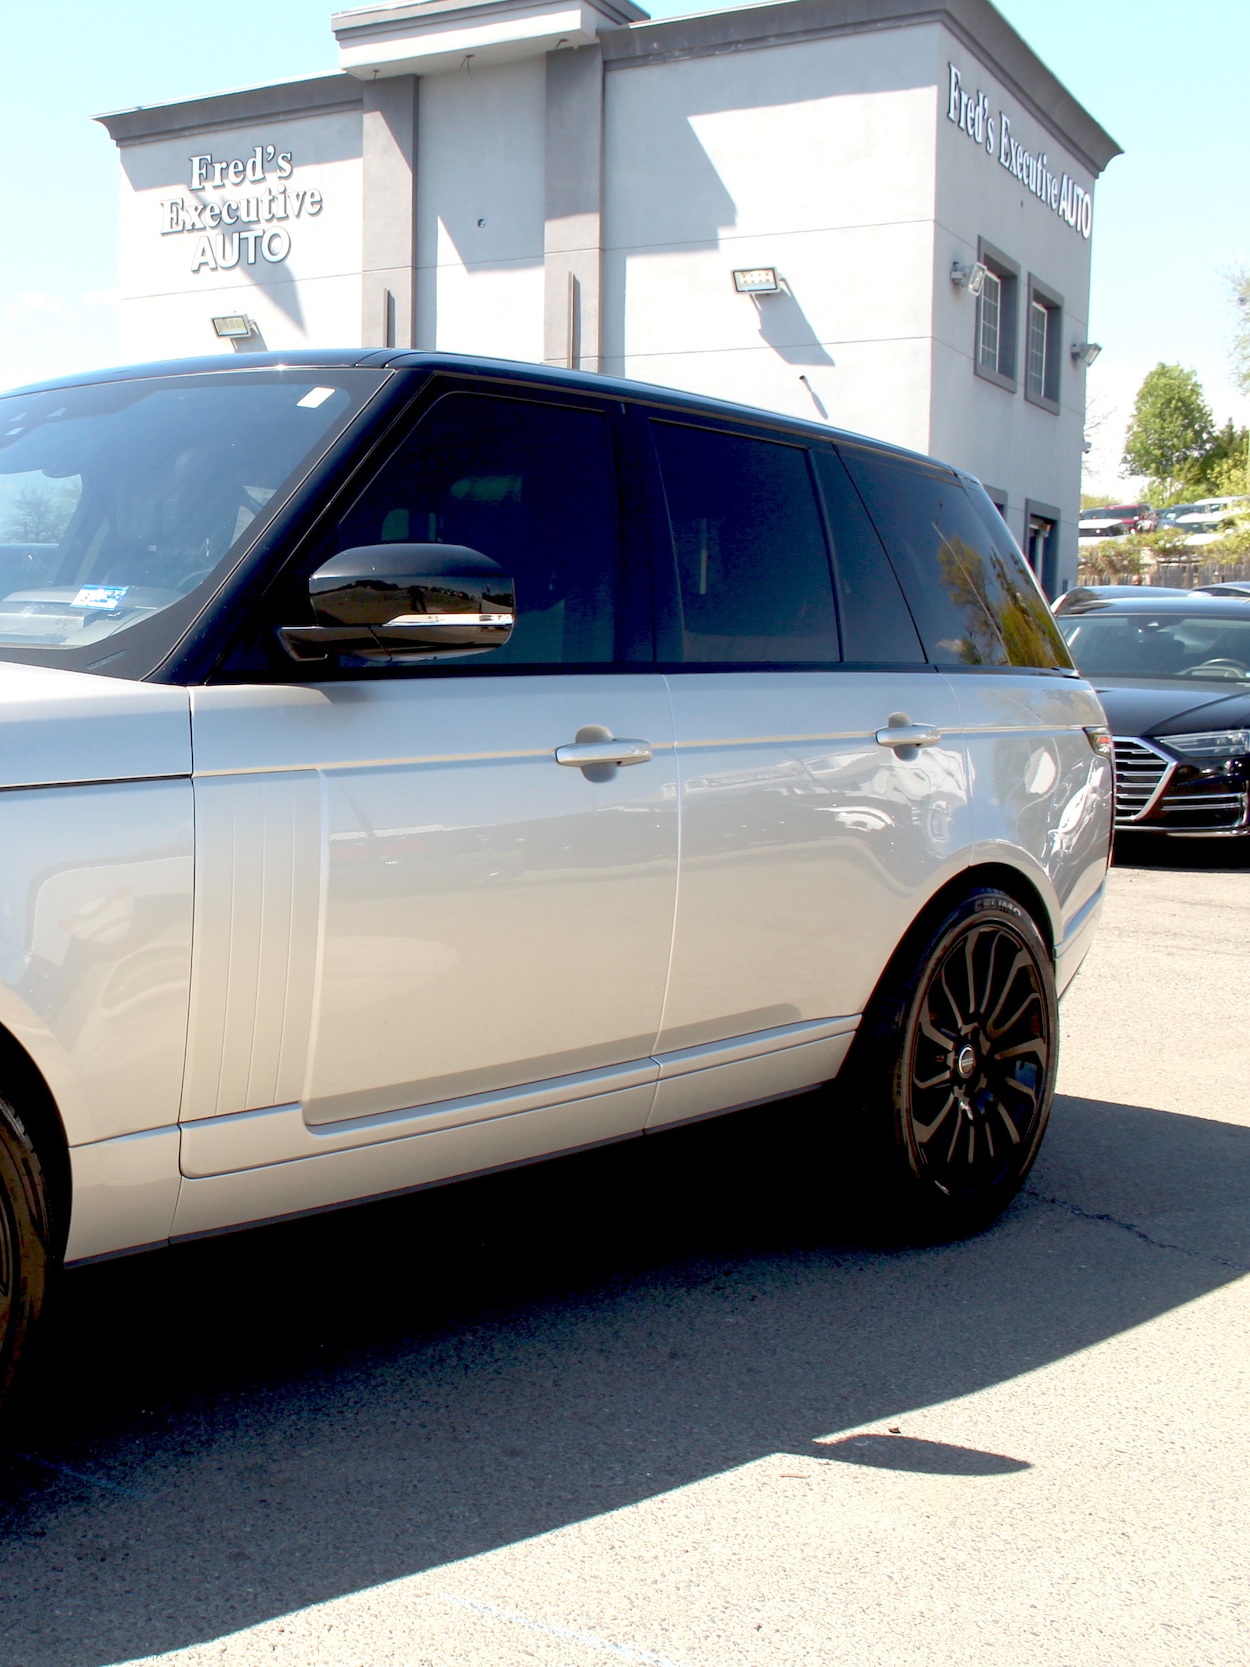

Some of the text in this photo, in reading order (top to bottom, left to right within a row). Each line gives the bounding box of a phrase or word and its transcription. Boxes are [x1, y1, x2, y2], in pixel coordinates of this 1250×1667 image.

[188, 144, 293, 192] Fred's
[947, 62, 1092, 240] Fred's Executive AUTO
[160, 184, 324, 236] Executive
[191, 226, 292, 273] AUTO
